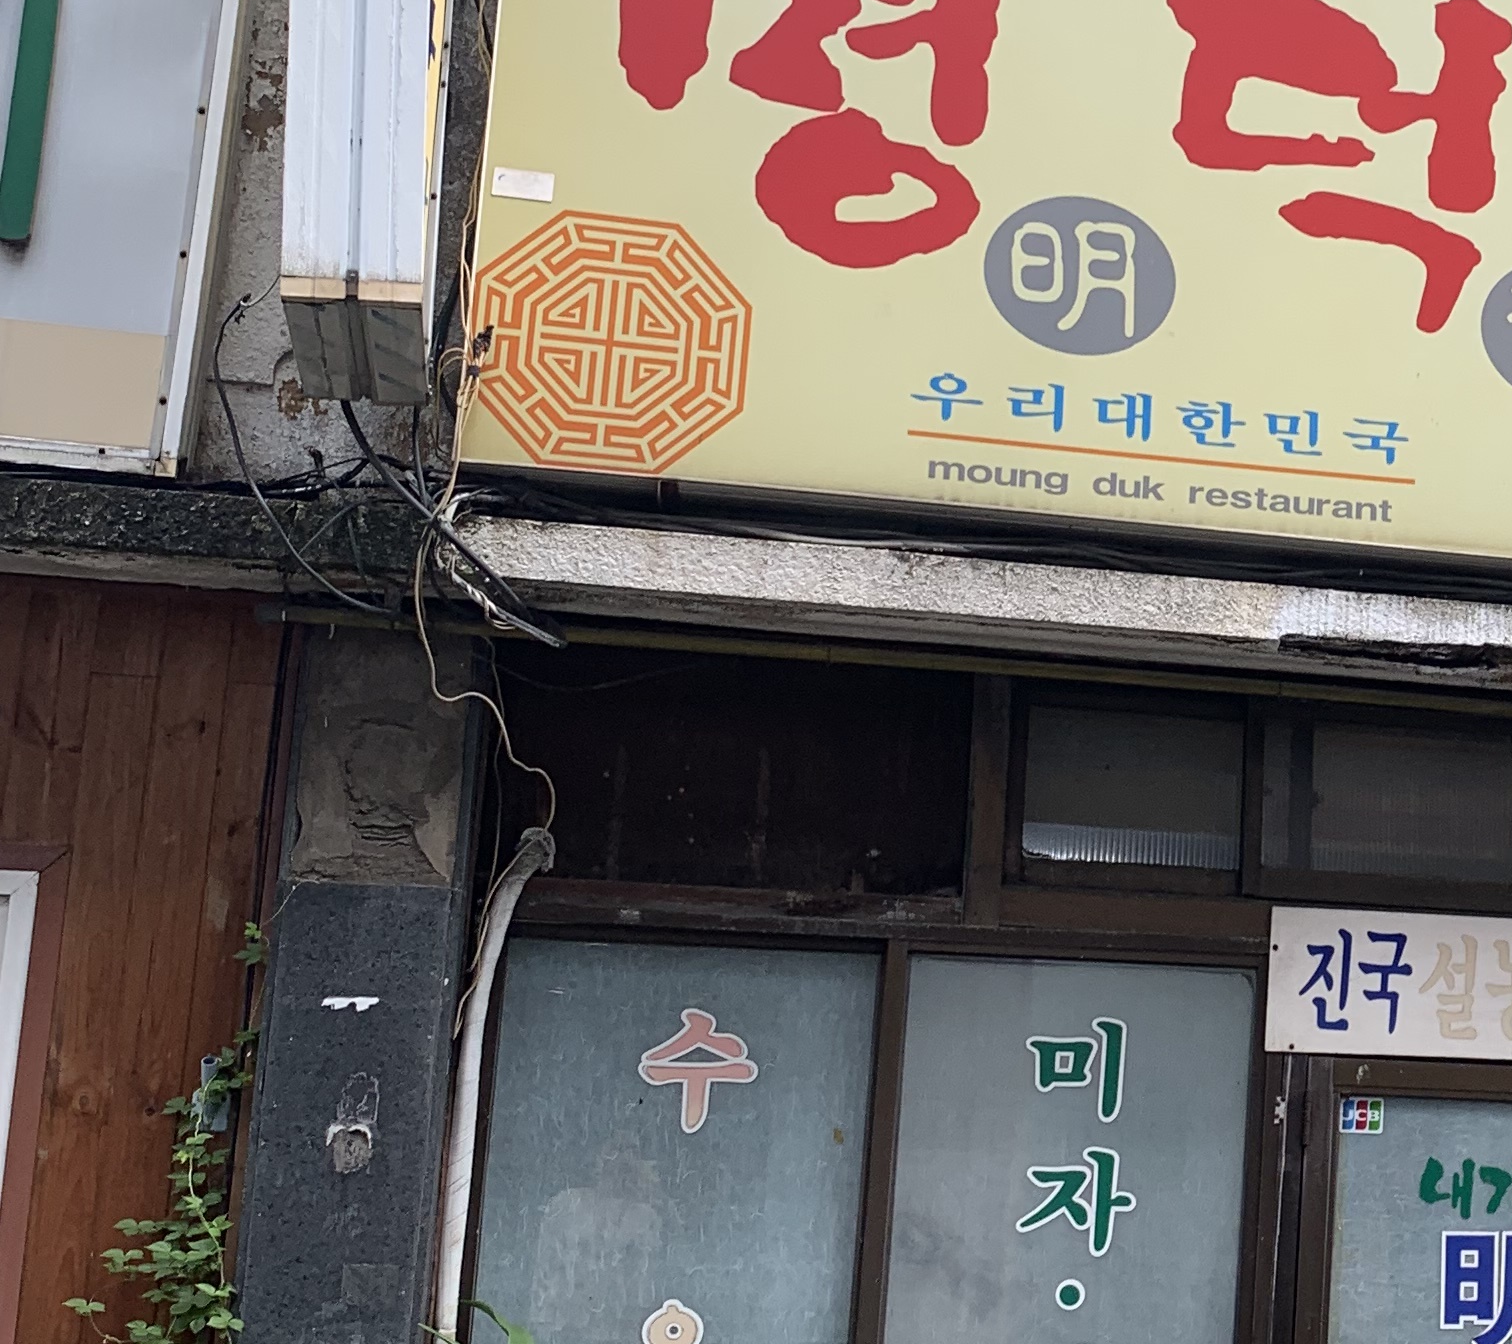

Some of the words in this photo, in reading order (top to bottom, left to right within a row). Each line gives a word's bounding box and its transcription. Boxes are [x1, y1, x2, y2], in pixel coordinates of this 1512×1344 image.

[910, 372, 1409, 465] 우리대한민국
[927, 457, 1069, 496] moung
[1092, 473, 1165, 502] duk
[1188, 481, 1393, 523] restaurant
[1342, 1109, 1380, 1121] JCB
